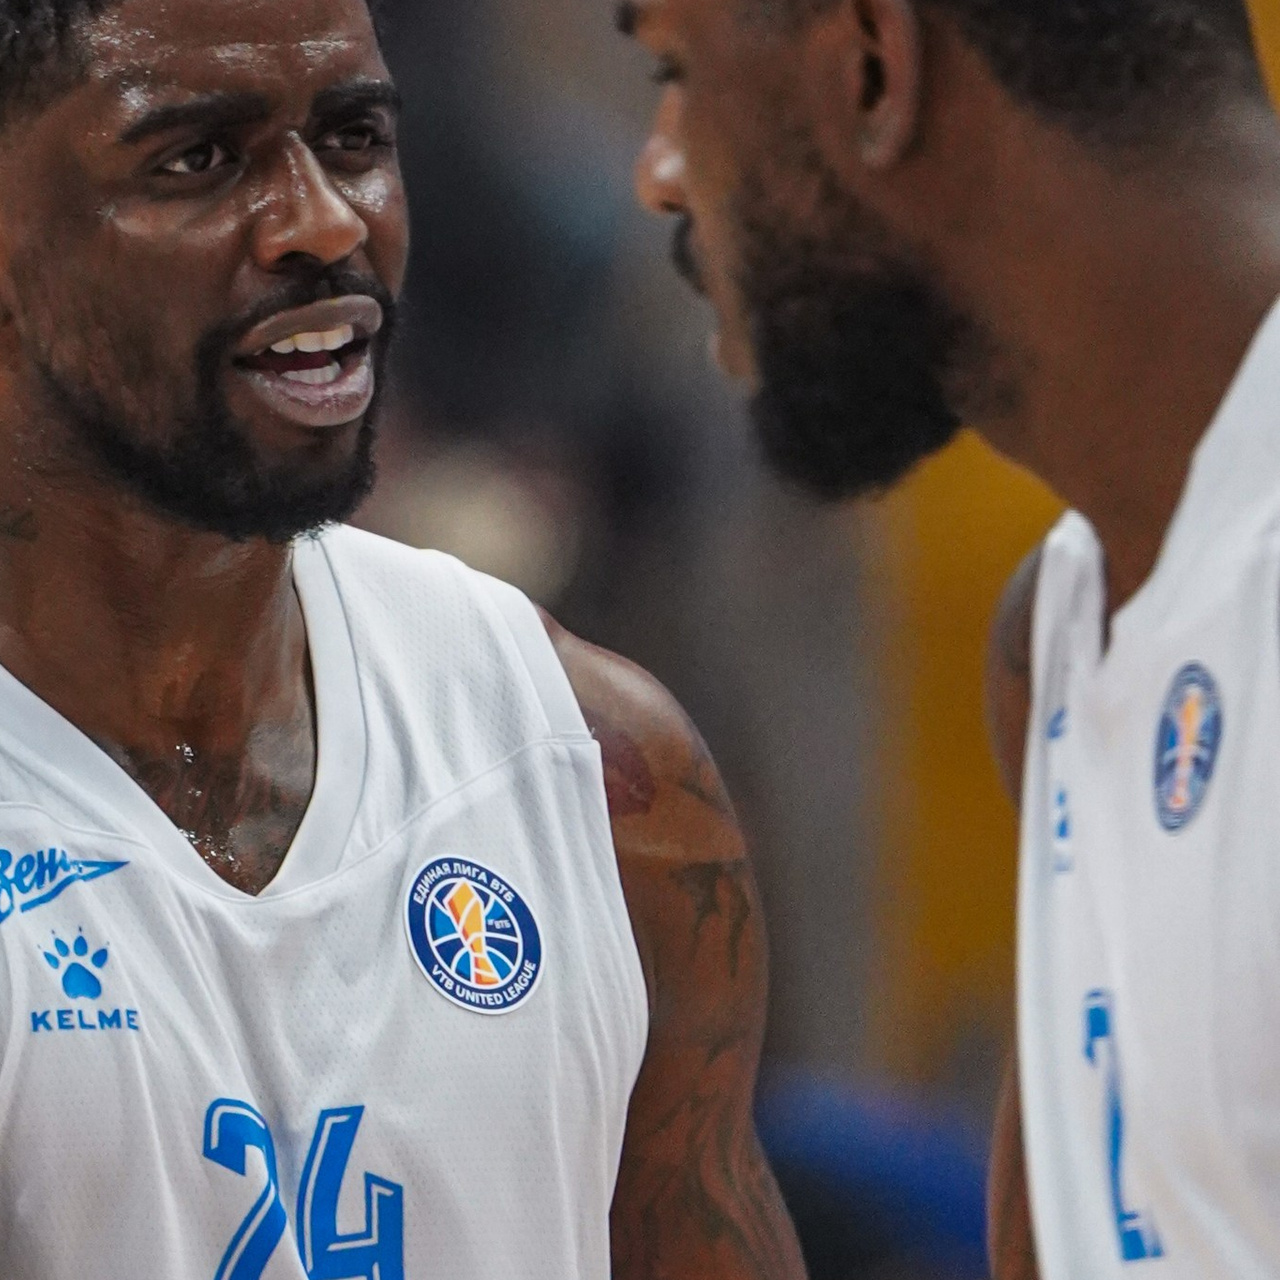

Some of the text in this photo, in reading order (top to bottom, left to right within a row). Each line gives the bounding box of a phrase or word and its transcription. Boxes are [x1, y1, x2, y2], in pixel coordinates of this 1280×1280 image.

[413, 862, 515, 905] ЕДИНАЯ ЛИГА ВТБ
[432, 959, 537, 1006] VTB UNITED LEAGUE
[31, 1008, 140, 1033] KELME
